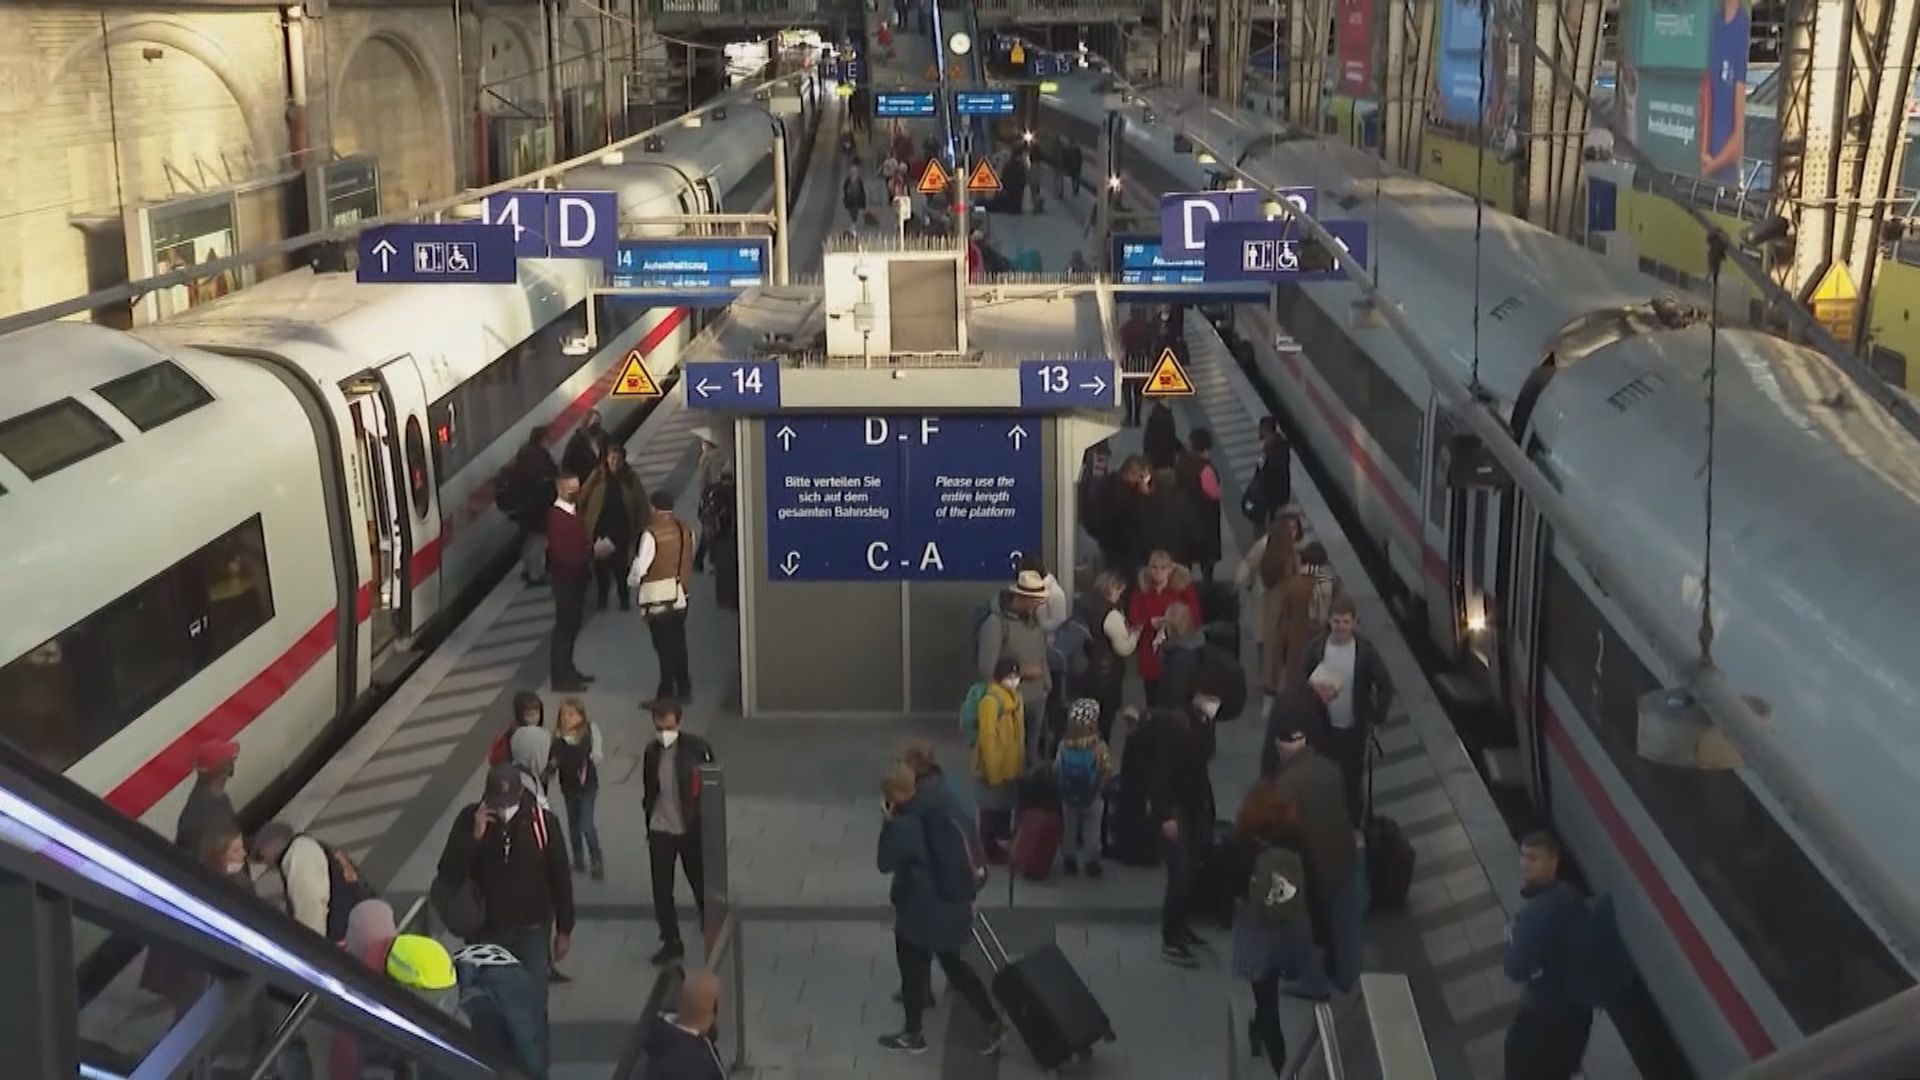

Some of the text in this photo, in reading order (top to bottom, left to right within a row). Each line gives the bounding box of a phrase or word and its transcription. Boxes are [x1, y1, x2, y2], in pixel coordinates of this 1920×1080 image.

[847, 62, 857, 77] E
[1035, 60, 1045, 75] E
[559, 197, 596, 248] D
[1183, 199, 1220, 250] D
[617, 249, 633, 267] 14
[732, 367, 763, 394] 14
[1038, 365, 1069, 392] 13
[865, 417, 888, 445] D
[921, 418, 940, 445] F
[784, 475, 882, 488] Bitte verteilen Sie
[935, 475, 1016, 488] Please use the
[798, 491, 869, 503] sich auf dem
[940, 491, 1010, 505] entire length
[777, 506, 890, 520] gesamten Bahnsteig
[935, 506, 1016, 520] of the platform
[867, 541, 889, 571] C
[919, 541, 945, 571] A
